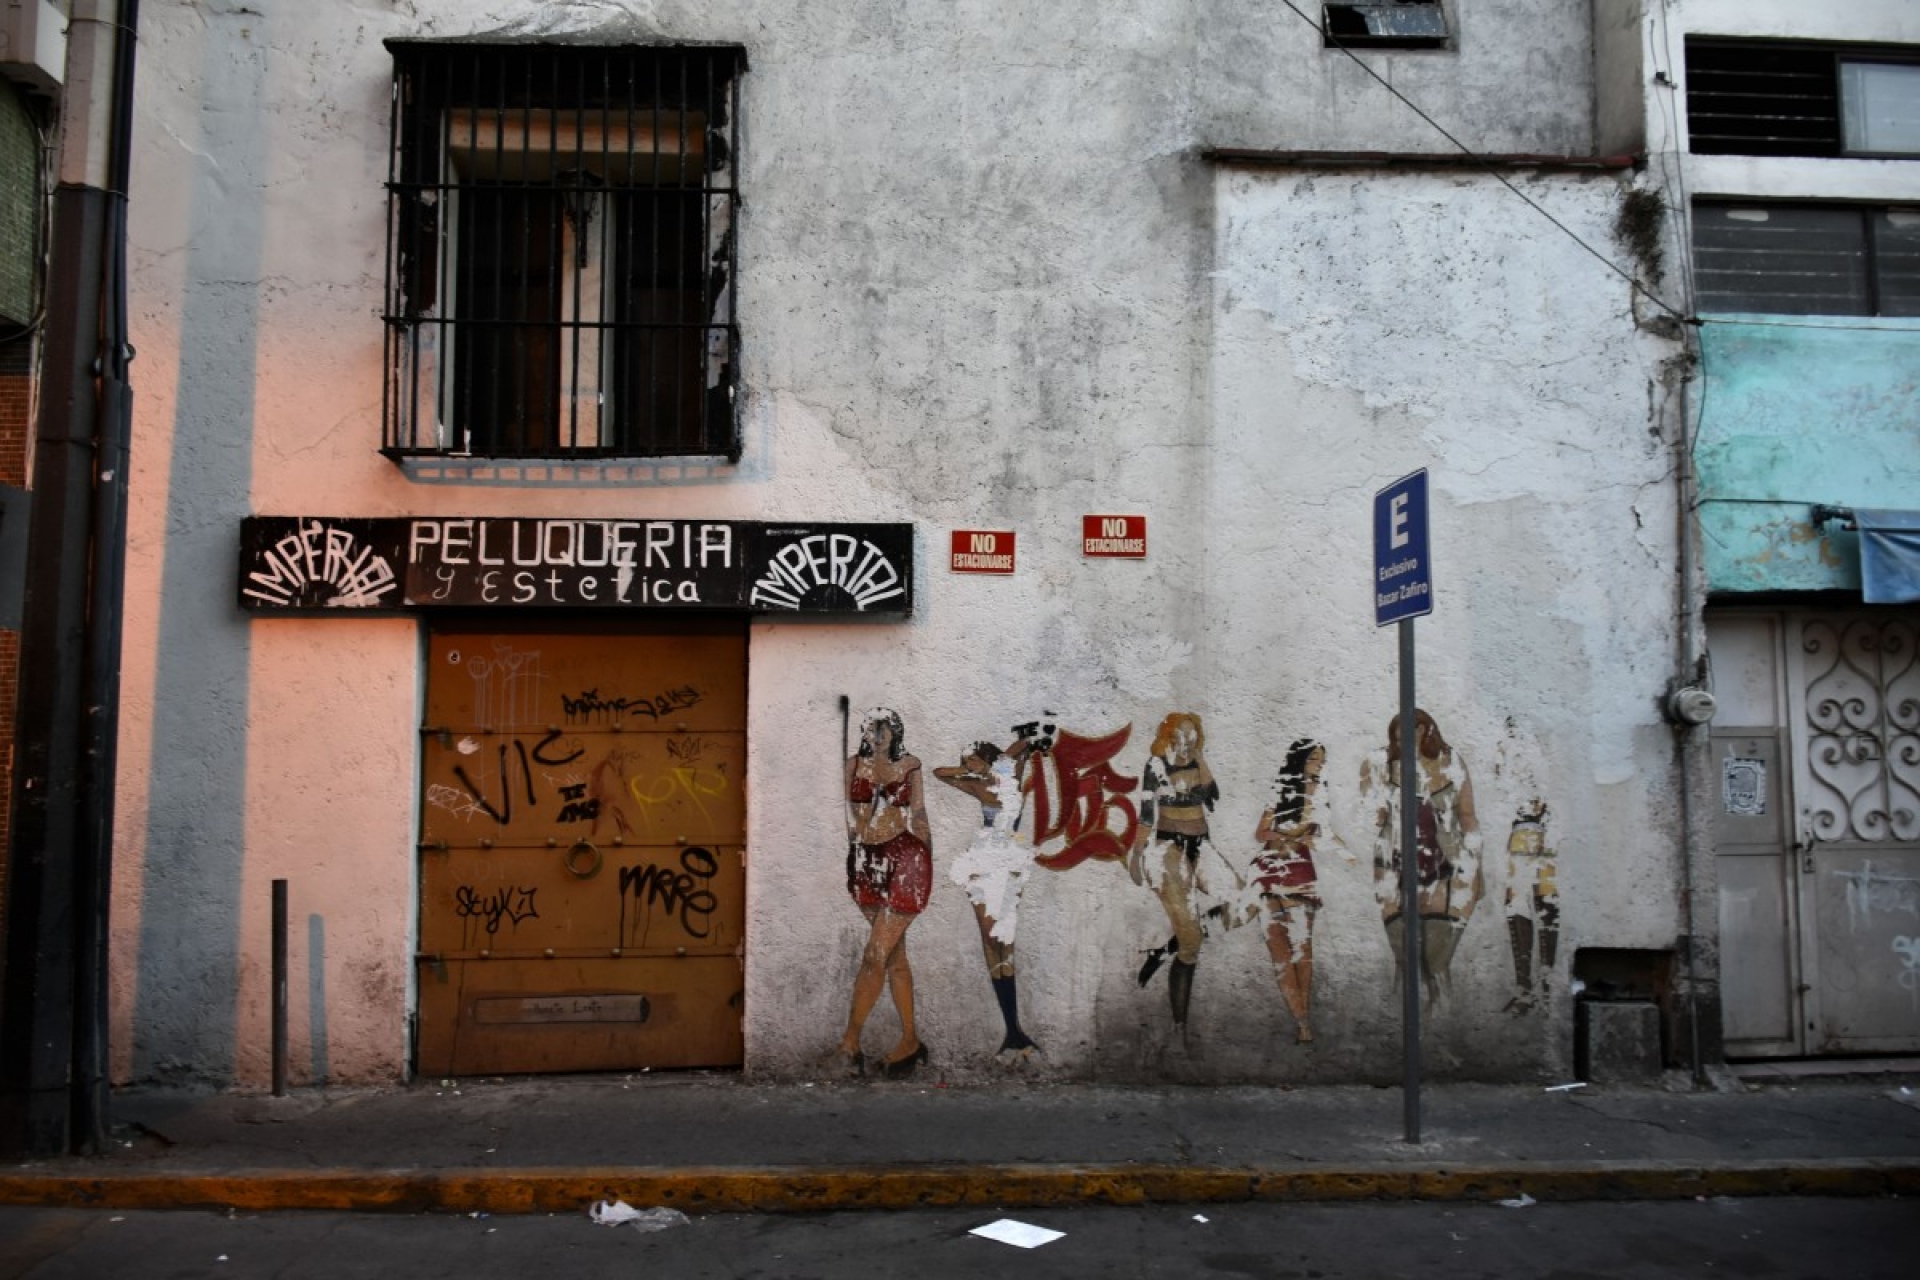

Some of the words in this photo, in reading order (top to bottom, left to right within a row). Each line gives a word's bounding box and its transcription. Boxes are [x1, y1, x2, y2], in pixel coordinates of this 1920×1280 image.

[1102, 518, 1127, 538] NO
[1390, 493, 1409, 549] E
[410, 520, 732, 569] PELUQUERIA
[970, 534, 996, 553] NO
[1085, 539, 1144, 553] ESTACIONARSE
[751, 534, 905, 612] IMPERIAL
[953, 554, 1012, 569] ESTACIONARSE
[431, 566, 456, 600] y
